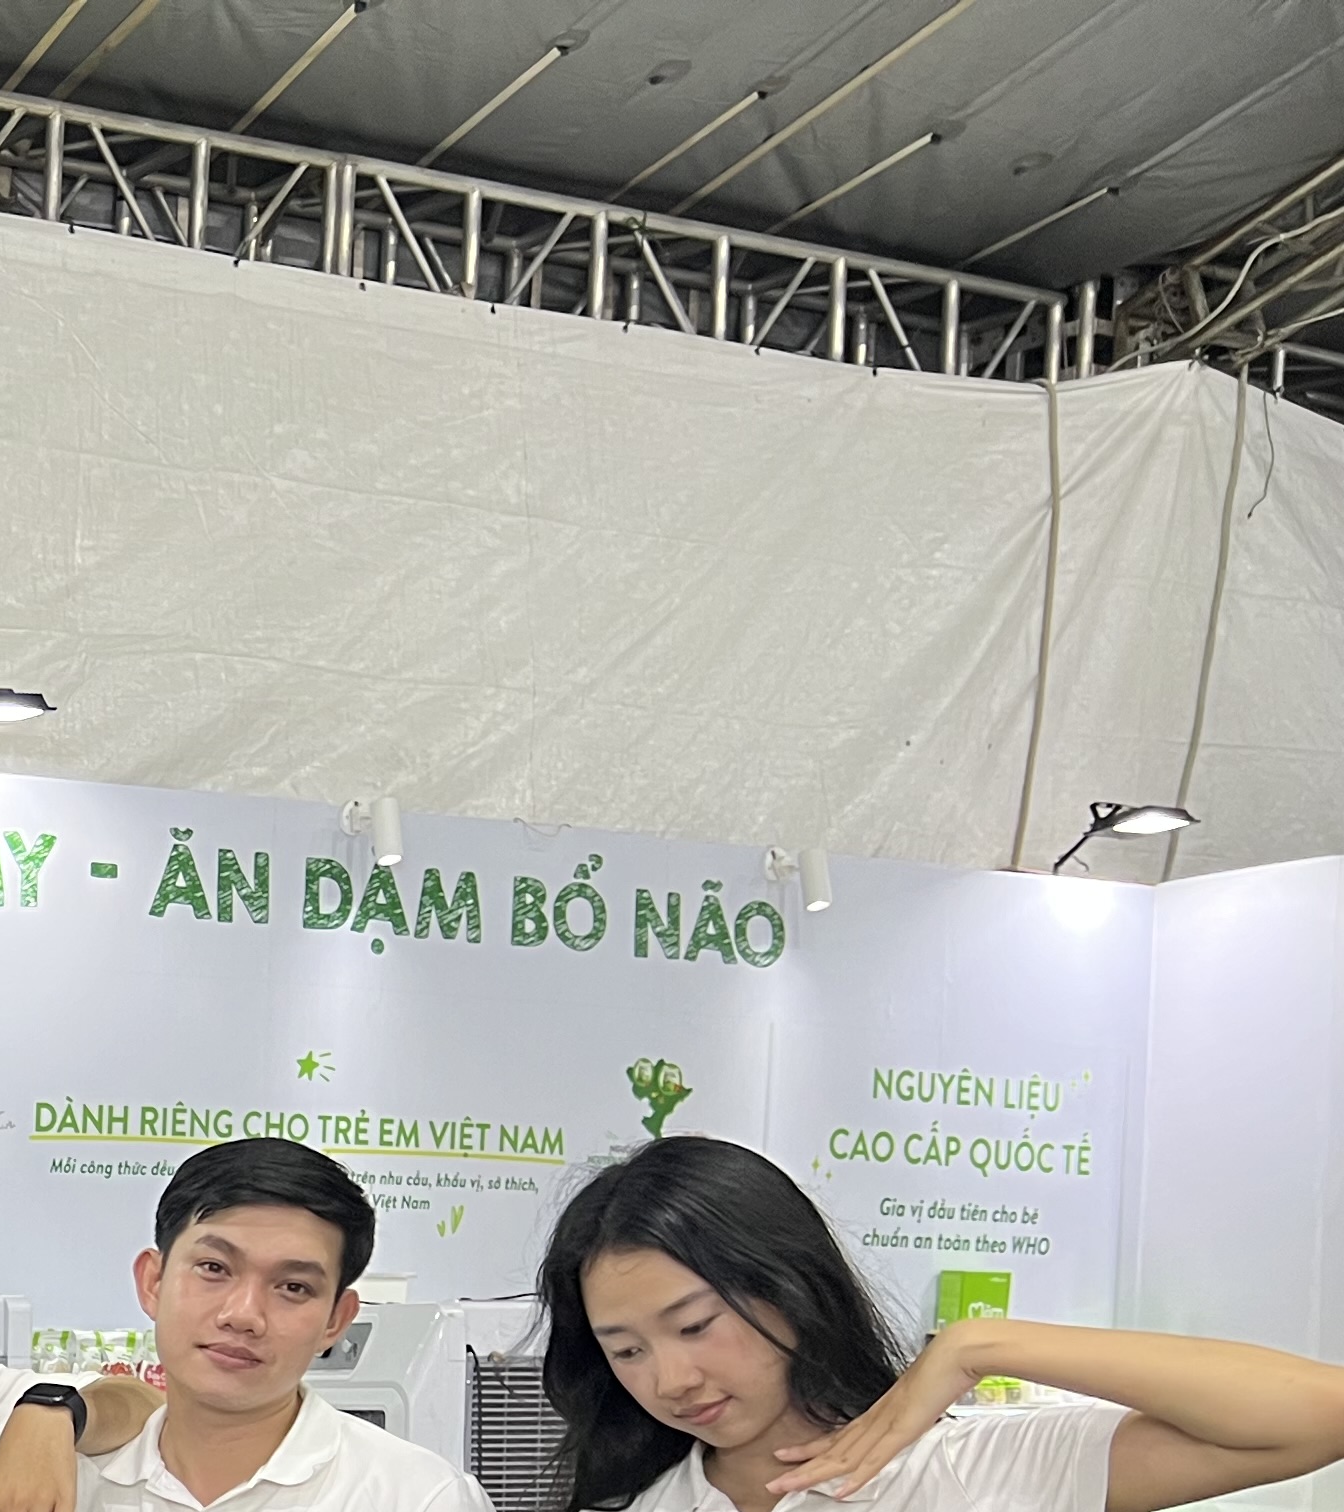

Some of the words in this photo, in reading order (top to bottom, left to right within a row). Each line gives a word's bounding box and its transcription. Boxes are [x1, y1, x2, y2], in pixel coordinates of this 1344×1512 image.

[148, 827, 270, 925] ĂN
[511, 854, 608, 952] BỔ
[634, 880, 785, 968] NÃO
[872, 1067, 995, 1108] NGUYÊN
[1004, 1073, 1061, 1120] LIỆU
[35, 1095, 129, 1135] DÀNH
[140, 1101, 233, 1139] RIÊNG
[242, 1110, 309, 1142] CHO
[318, 1109, 370, 1146] TRẺ
[379, 1118, 420, 1148] EM
[429, 1116, 491, 1158] VIỆT
[499, 1124, 565, 1156] NAM
[829, 1128, 895, 1162] CAO
[903, 1120, 961, 1167] CẤP
[969, 1127, 1055, 1178] QUỐC
[1062, 1131, 1092, 1176] TẾ
[80, 1161, 112, 1179] công
[379, 1172, 402, 1186] nhu
[401, 1197, 430, 1211] Nam
[879, 1197, 905, 1218] Gia
[911, 1200, 925, 1224] vị
[992, 1203, 1017, 1224] cho
[862, 1227, 909, 1249] chuẩn
[913, 1236, 932, 1249] an
[937, 1232, 970, 1251] toàn
[975, 1233, 1007, 1254] theo
[1012, 1236, 1050, 1256] WHO
